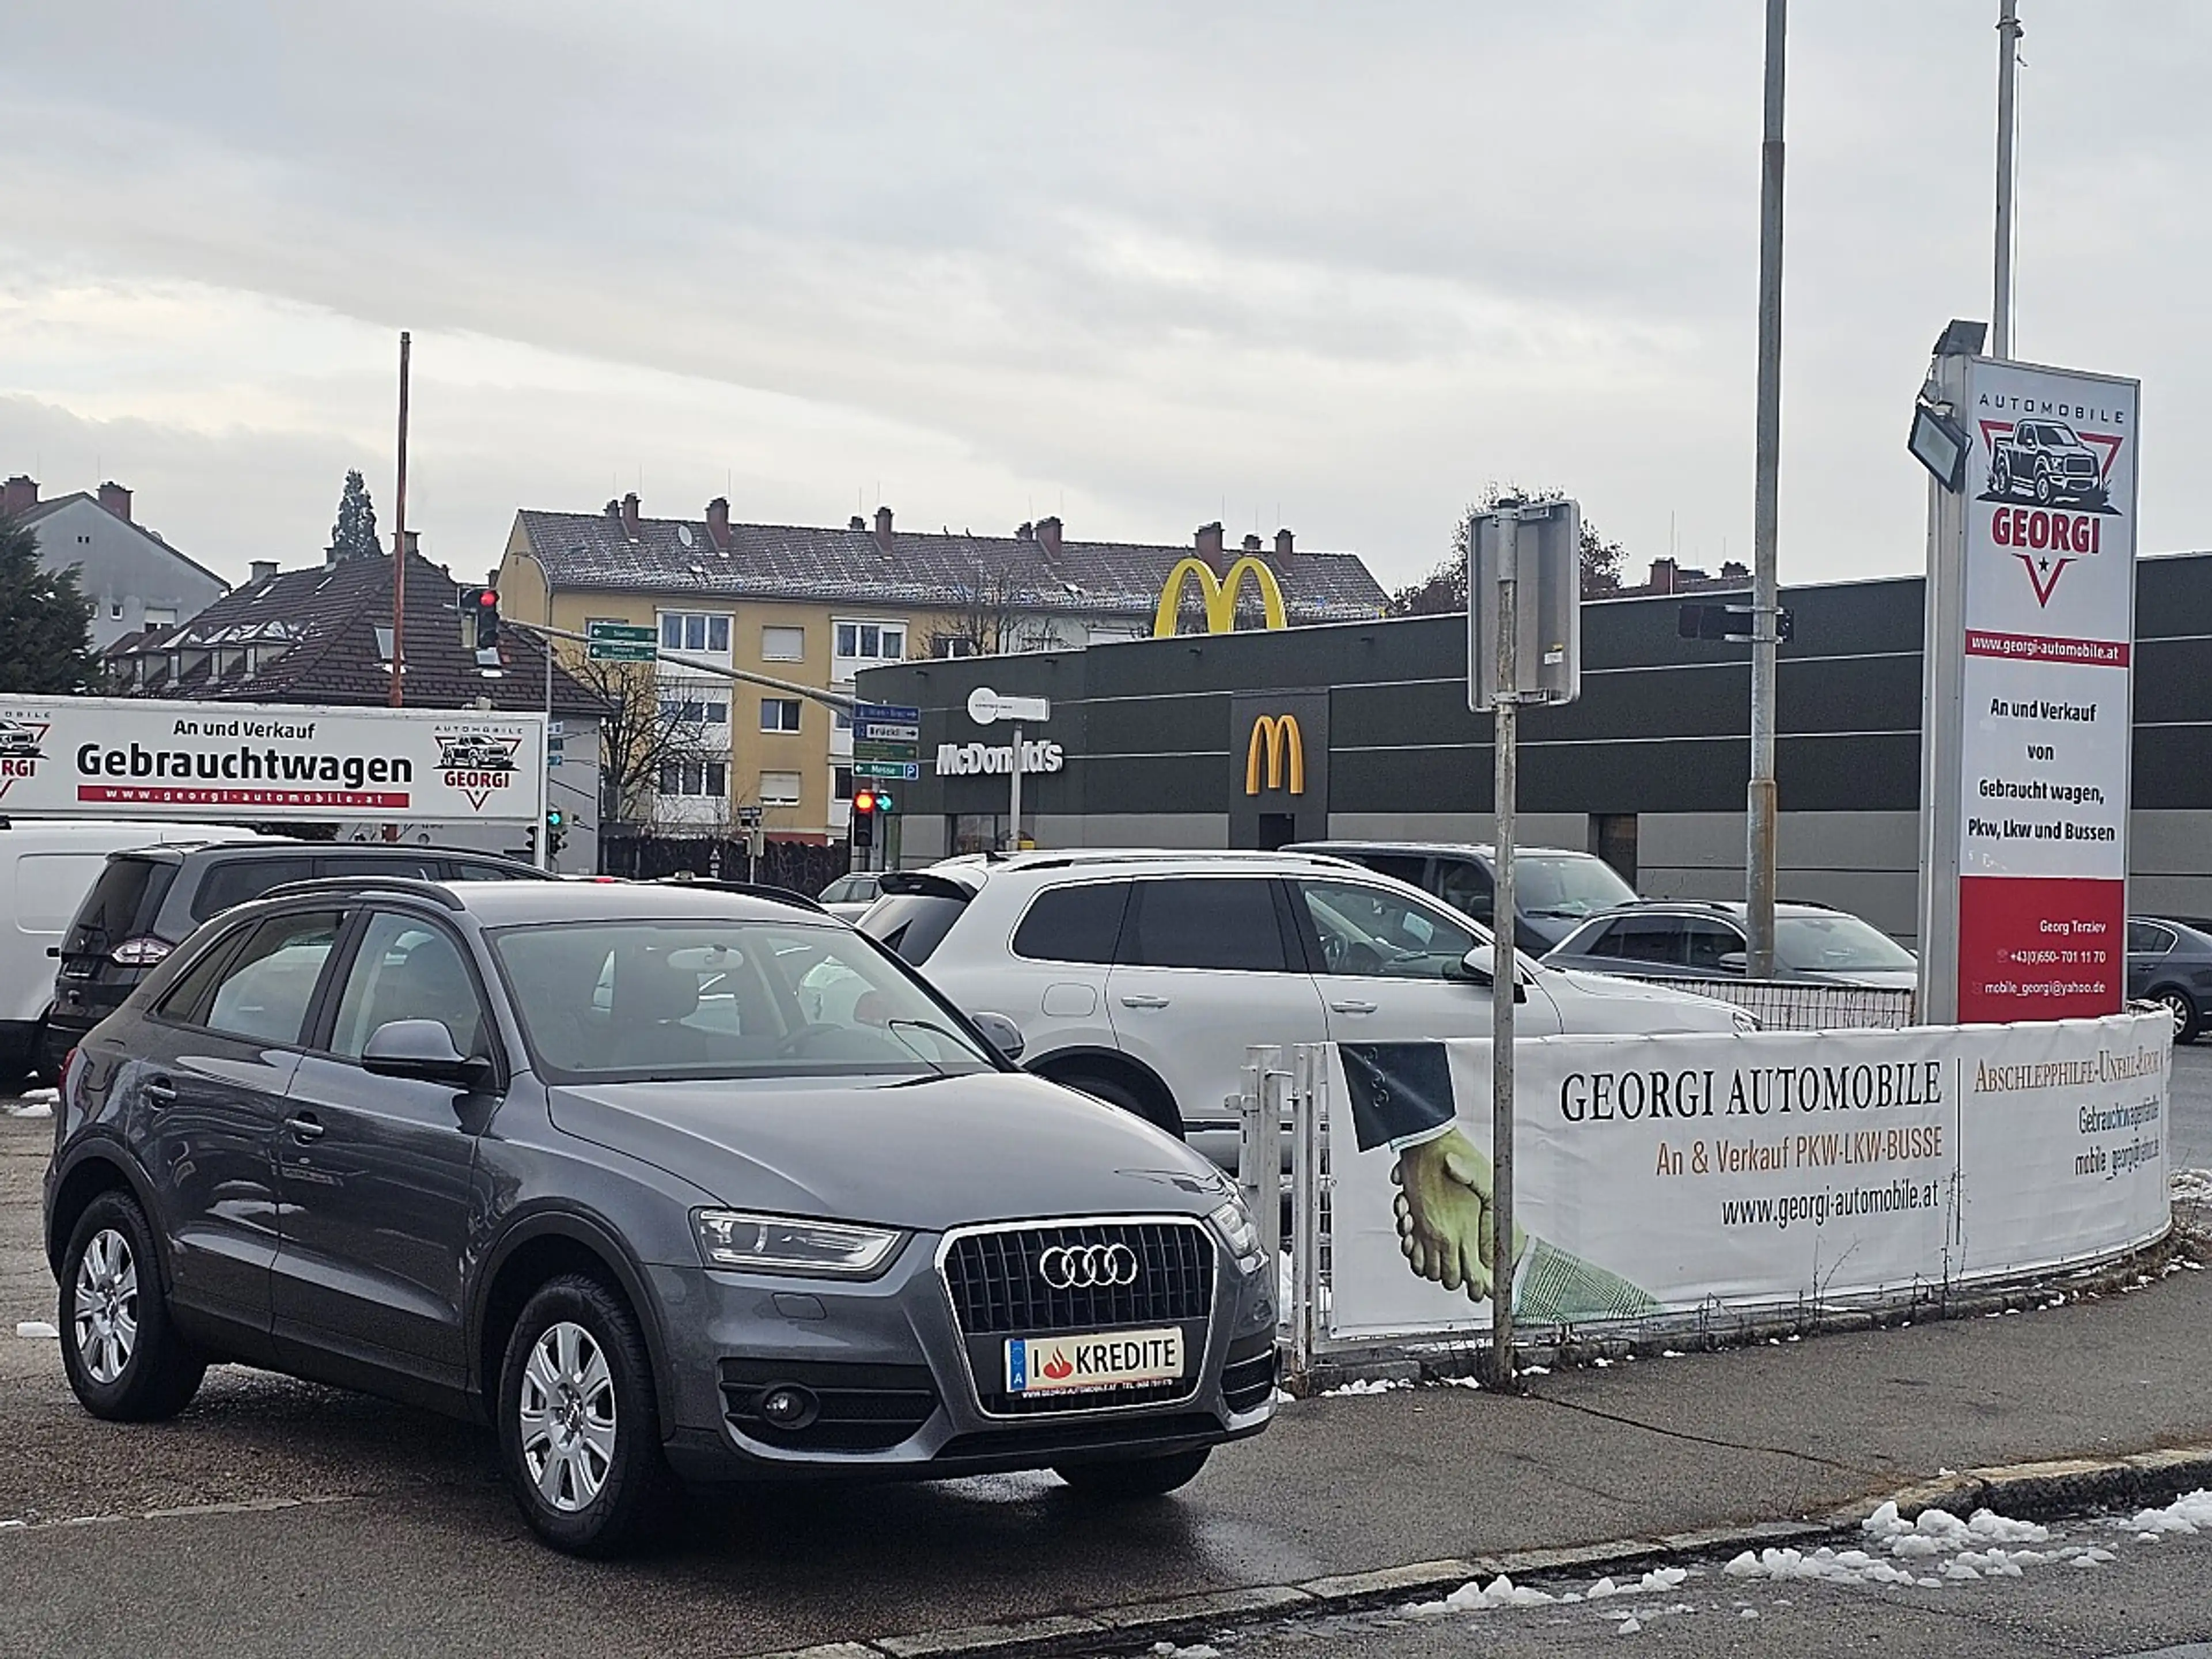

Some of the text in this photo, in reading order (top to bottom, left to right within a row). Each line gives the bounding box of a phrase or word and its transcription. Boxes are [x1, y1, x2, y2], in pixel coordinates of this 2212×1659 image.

[1979, 393, 2123, 424] AUTOMOBILE
[1992, 506, 2101, 555] GEORGI
[1972, 637, 2119, 660] www.georgi-automobile.at
[1990, 698, 2097, 722] An und Verkauf
[173, 720, 316, 740] An und Verkauf
[936, 740, 1063, 775] McDonld's
[2027, 744, 2054, 761] von
[77, 743, 412, 788] Gebrauchtwagen
[444, 771, 510, 788] GEORGI
[105, 789, 384, 805] www.georgi-automobile.at
[1979, 779, 2105, 805] Gebraucht wagen,
[1968, 817, 2115, 842] Pkw, Lkw und Bussen
[2040, 920, 2069, 935] Georg
[2010, 950, 2106, 965] +43(0)650- 701 11 70
[1985, 981, 2106, 997] mobile_georgi@yahoo.de
[1560, 1061, 1942, 1122] GEORGI AUTOMOBILE
[1657, 1126, 1942, 1176] An & Verkauf PKW-LKW-BUSSE
[1722, 1179, 1938, 1228] www.georgi-automobile.at
[1076, 1339, 1176, 1374] KREDITE
[1013, 1373, 1023, 1384] A
